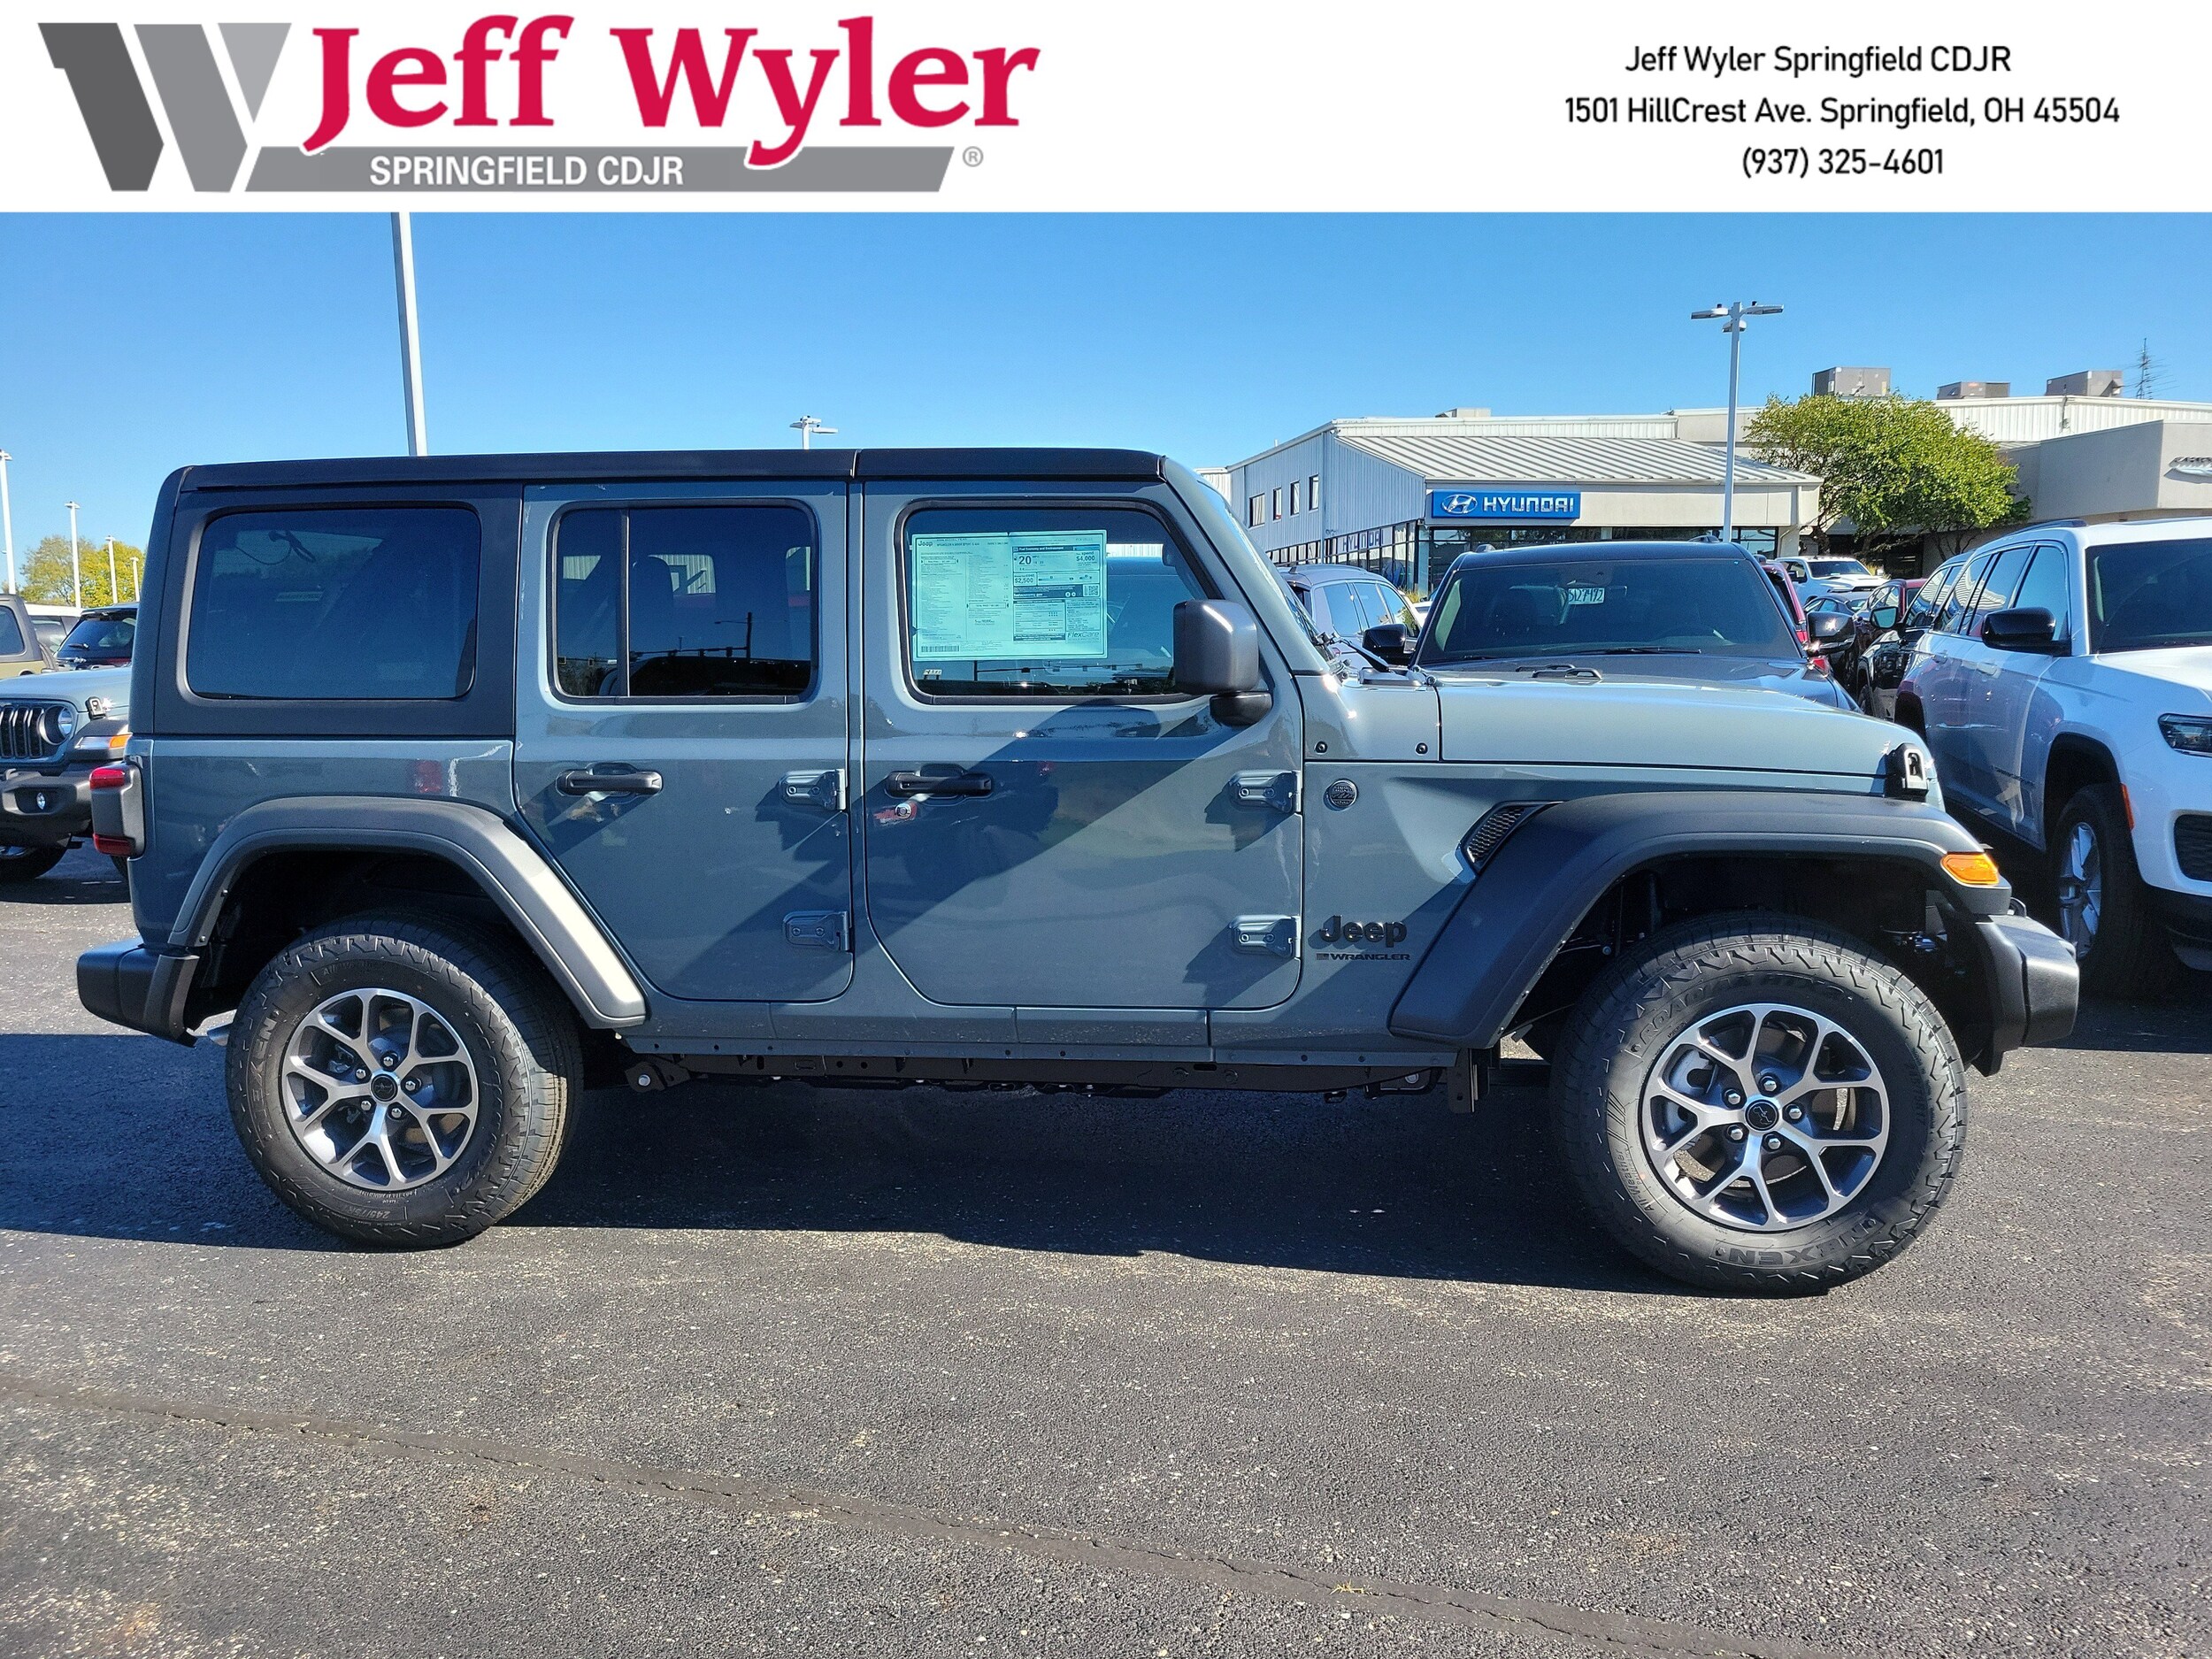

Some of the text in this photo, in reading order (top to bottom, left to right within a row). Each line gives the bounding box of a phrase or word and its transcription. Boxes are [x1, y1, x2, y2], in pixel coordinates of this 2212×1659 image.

[1483, 497, 1574, 513] HYUNDAI
[1018, 556, 1032, 565] 20
[1318, 915, 1407, 948] Jeep
[1728, 1219, 1870, 1266] NEXEN
